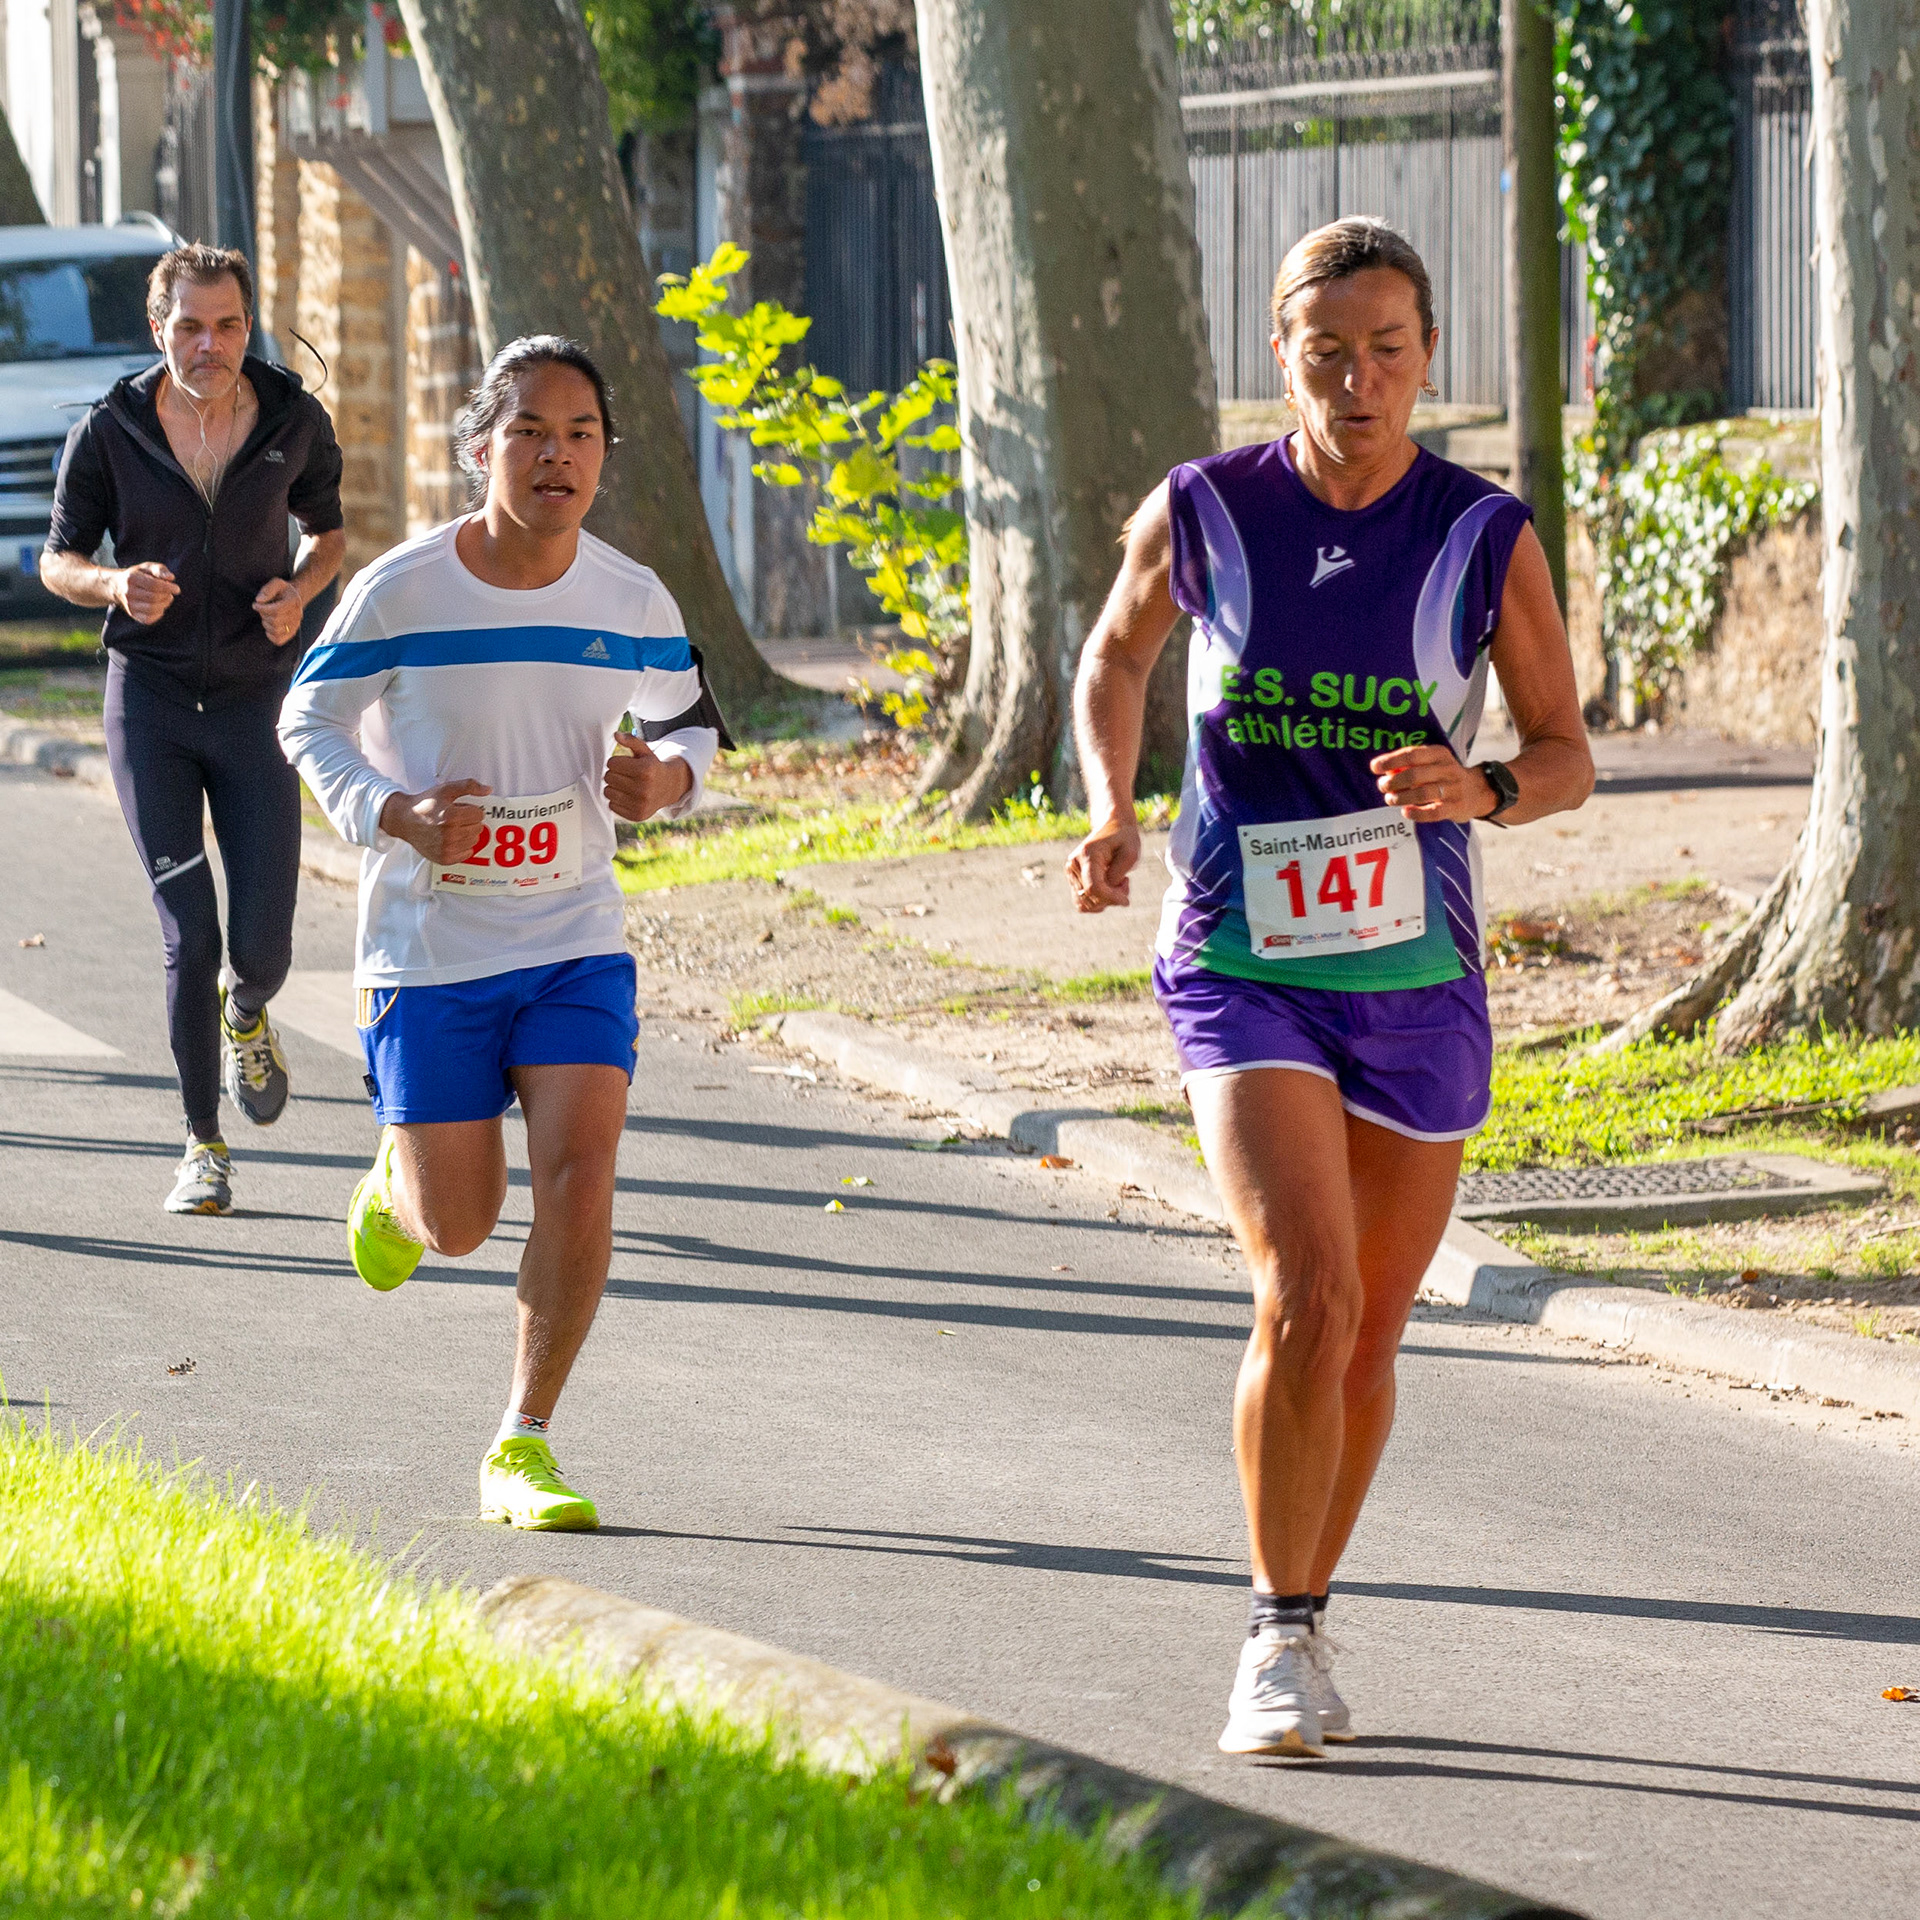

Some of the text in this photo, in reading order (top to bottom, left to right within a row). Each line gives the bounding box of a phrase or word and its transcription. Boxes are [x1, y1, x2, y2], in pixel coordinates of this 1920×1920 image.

[1221, 665, 1438, 717] E.S. SUCY
[1225, 712, 1427, 750] athlétisme
[462, 821, 558, 868] 289
[1250, 822, 1406, 856] Saint-Maurienne
[1276, 847, 1389, 918] 147
